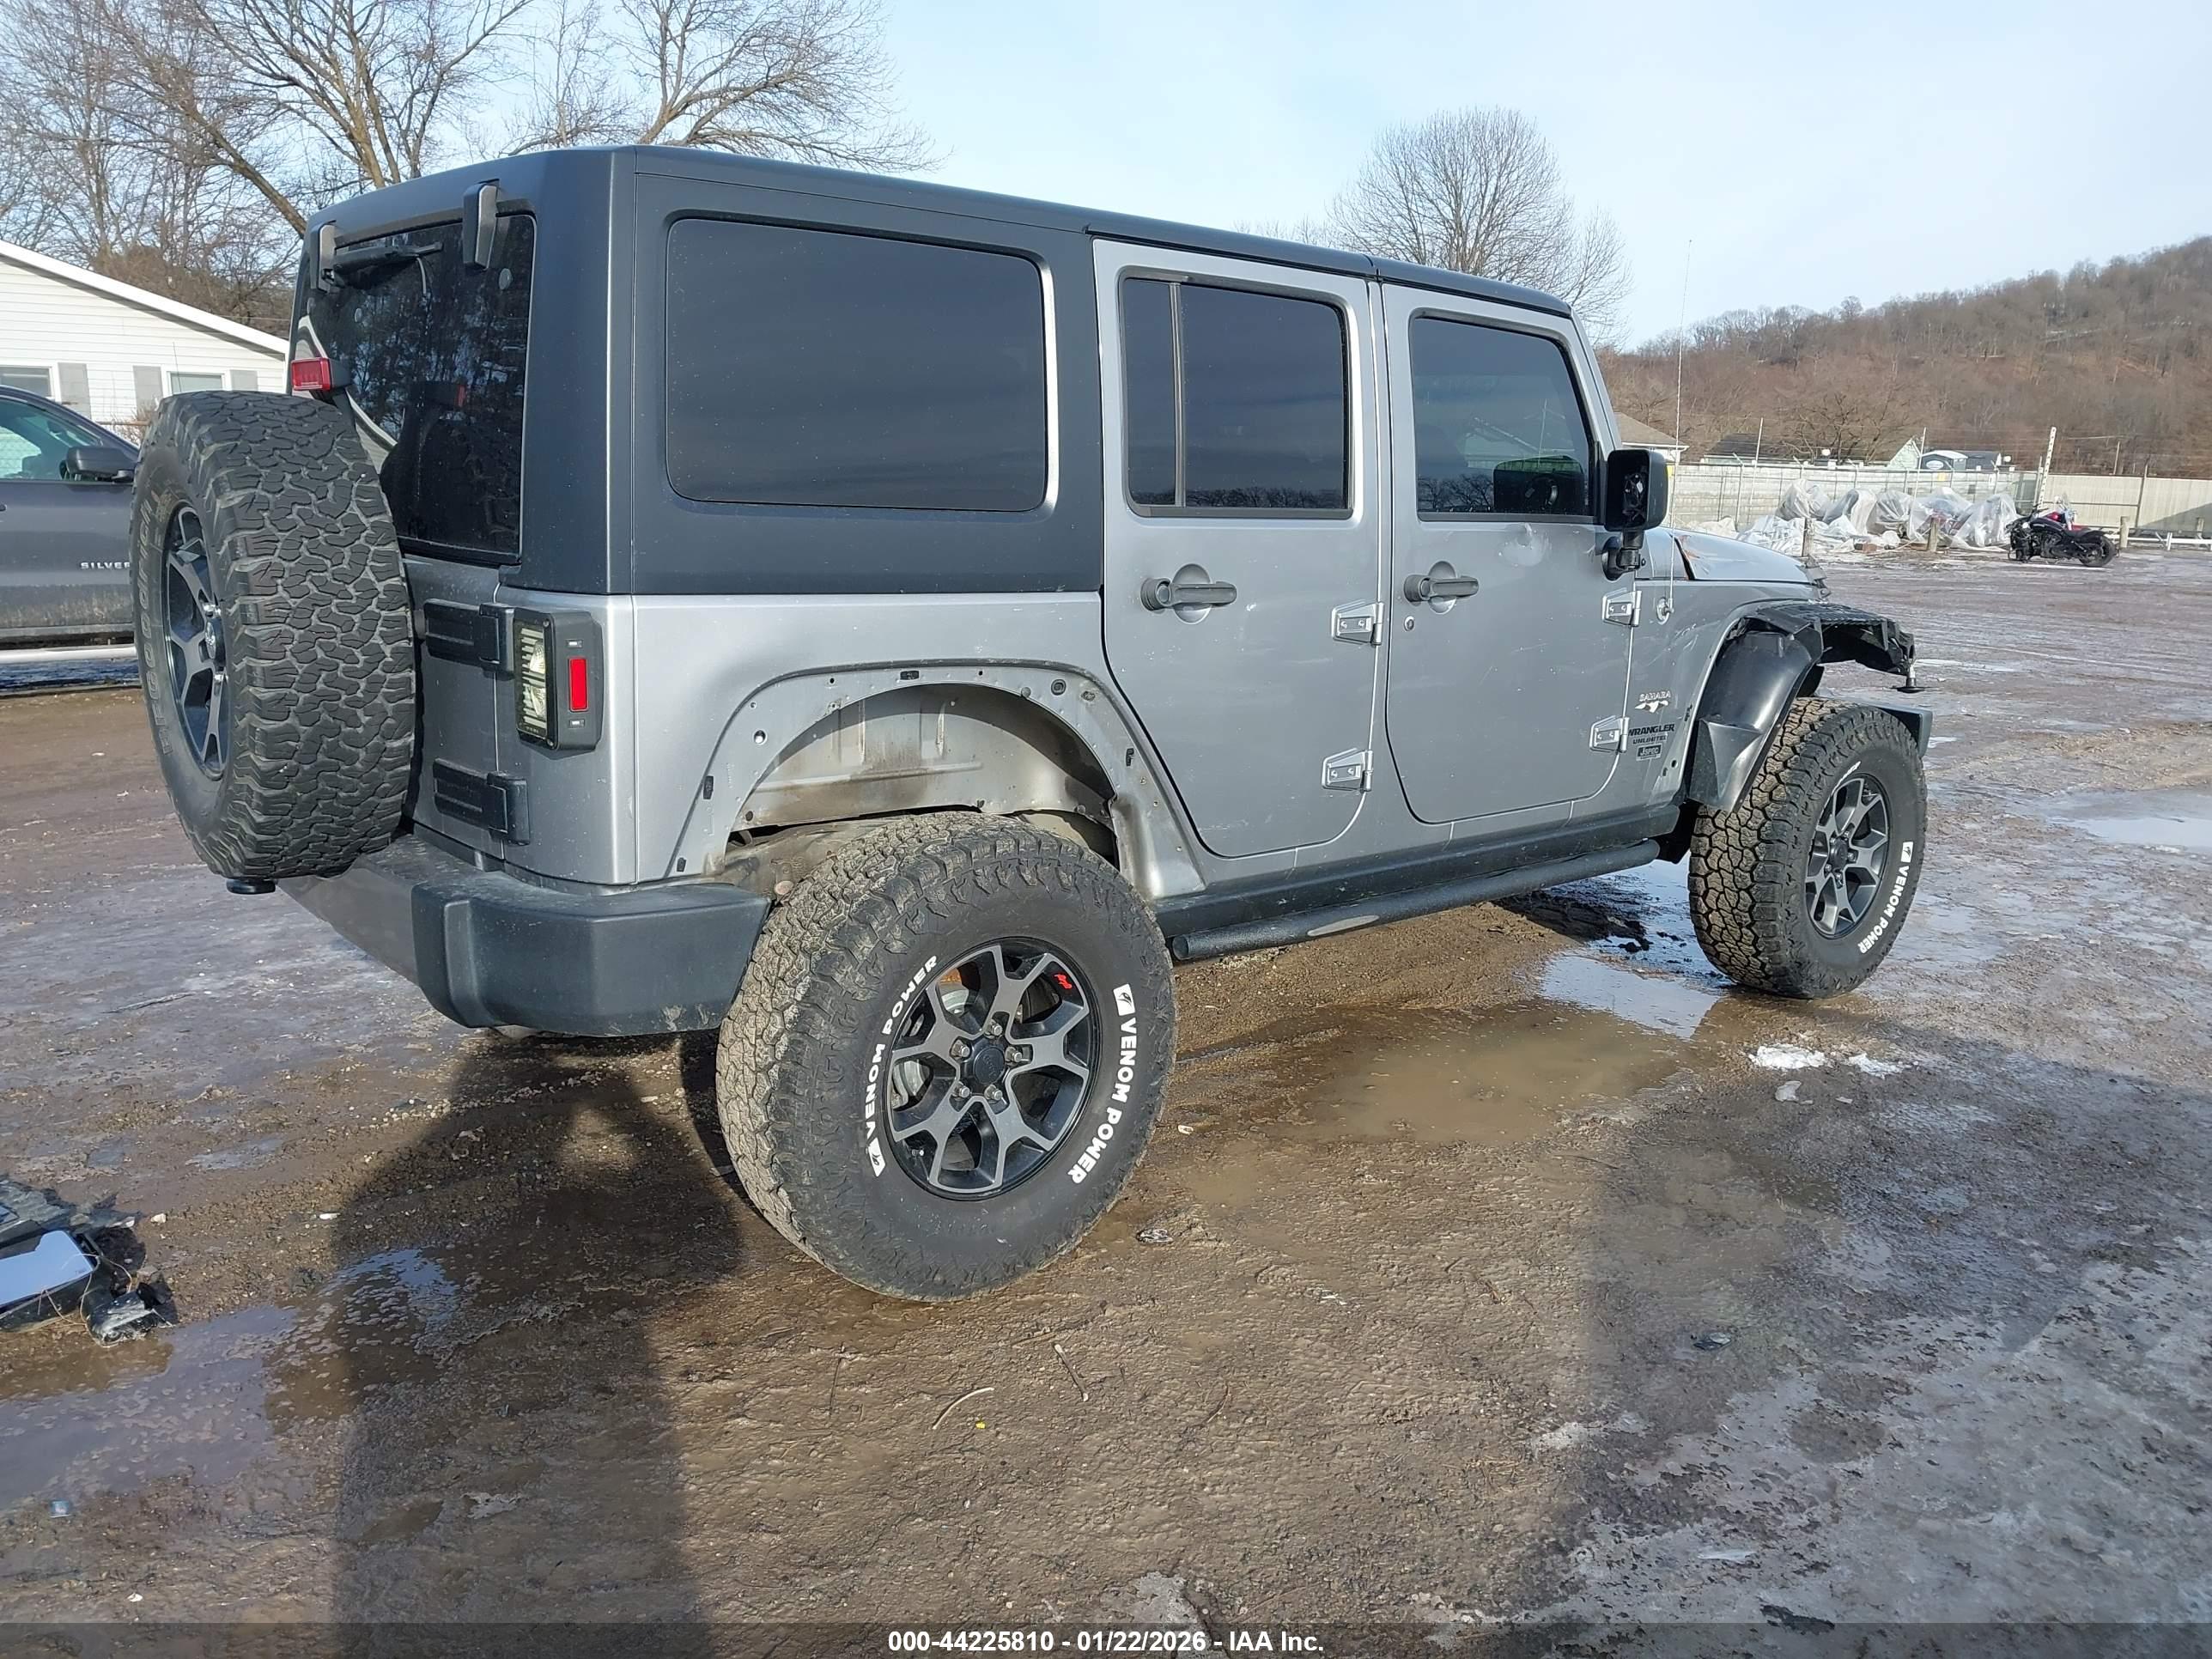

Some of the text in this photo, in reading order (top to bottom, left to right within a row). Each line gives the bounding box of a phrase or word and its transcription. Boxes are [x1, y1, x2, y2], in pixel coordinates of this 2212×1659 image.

[1628, 723, 1675, 737] WRANGLER
[1638, 690, 1672, 702] SAHARA
[1857, 866, 1910, 954] VENOM POWER
[865, 955, 938, 1139] VENOM POWER
[1067, 1018, 1137, 1184] VENOM POWER
